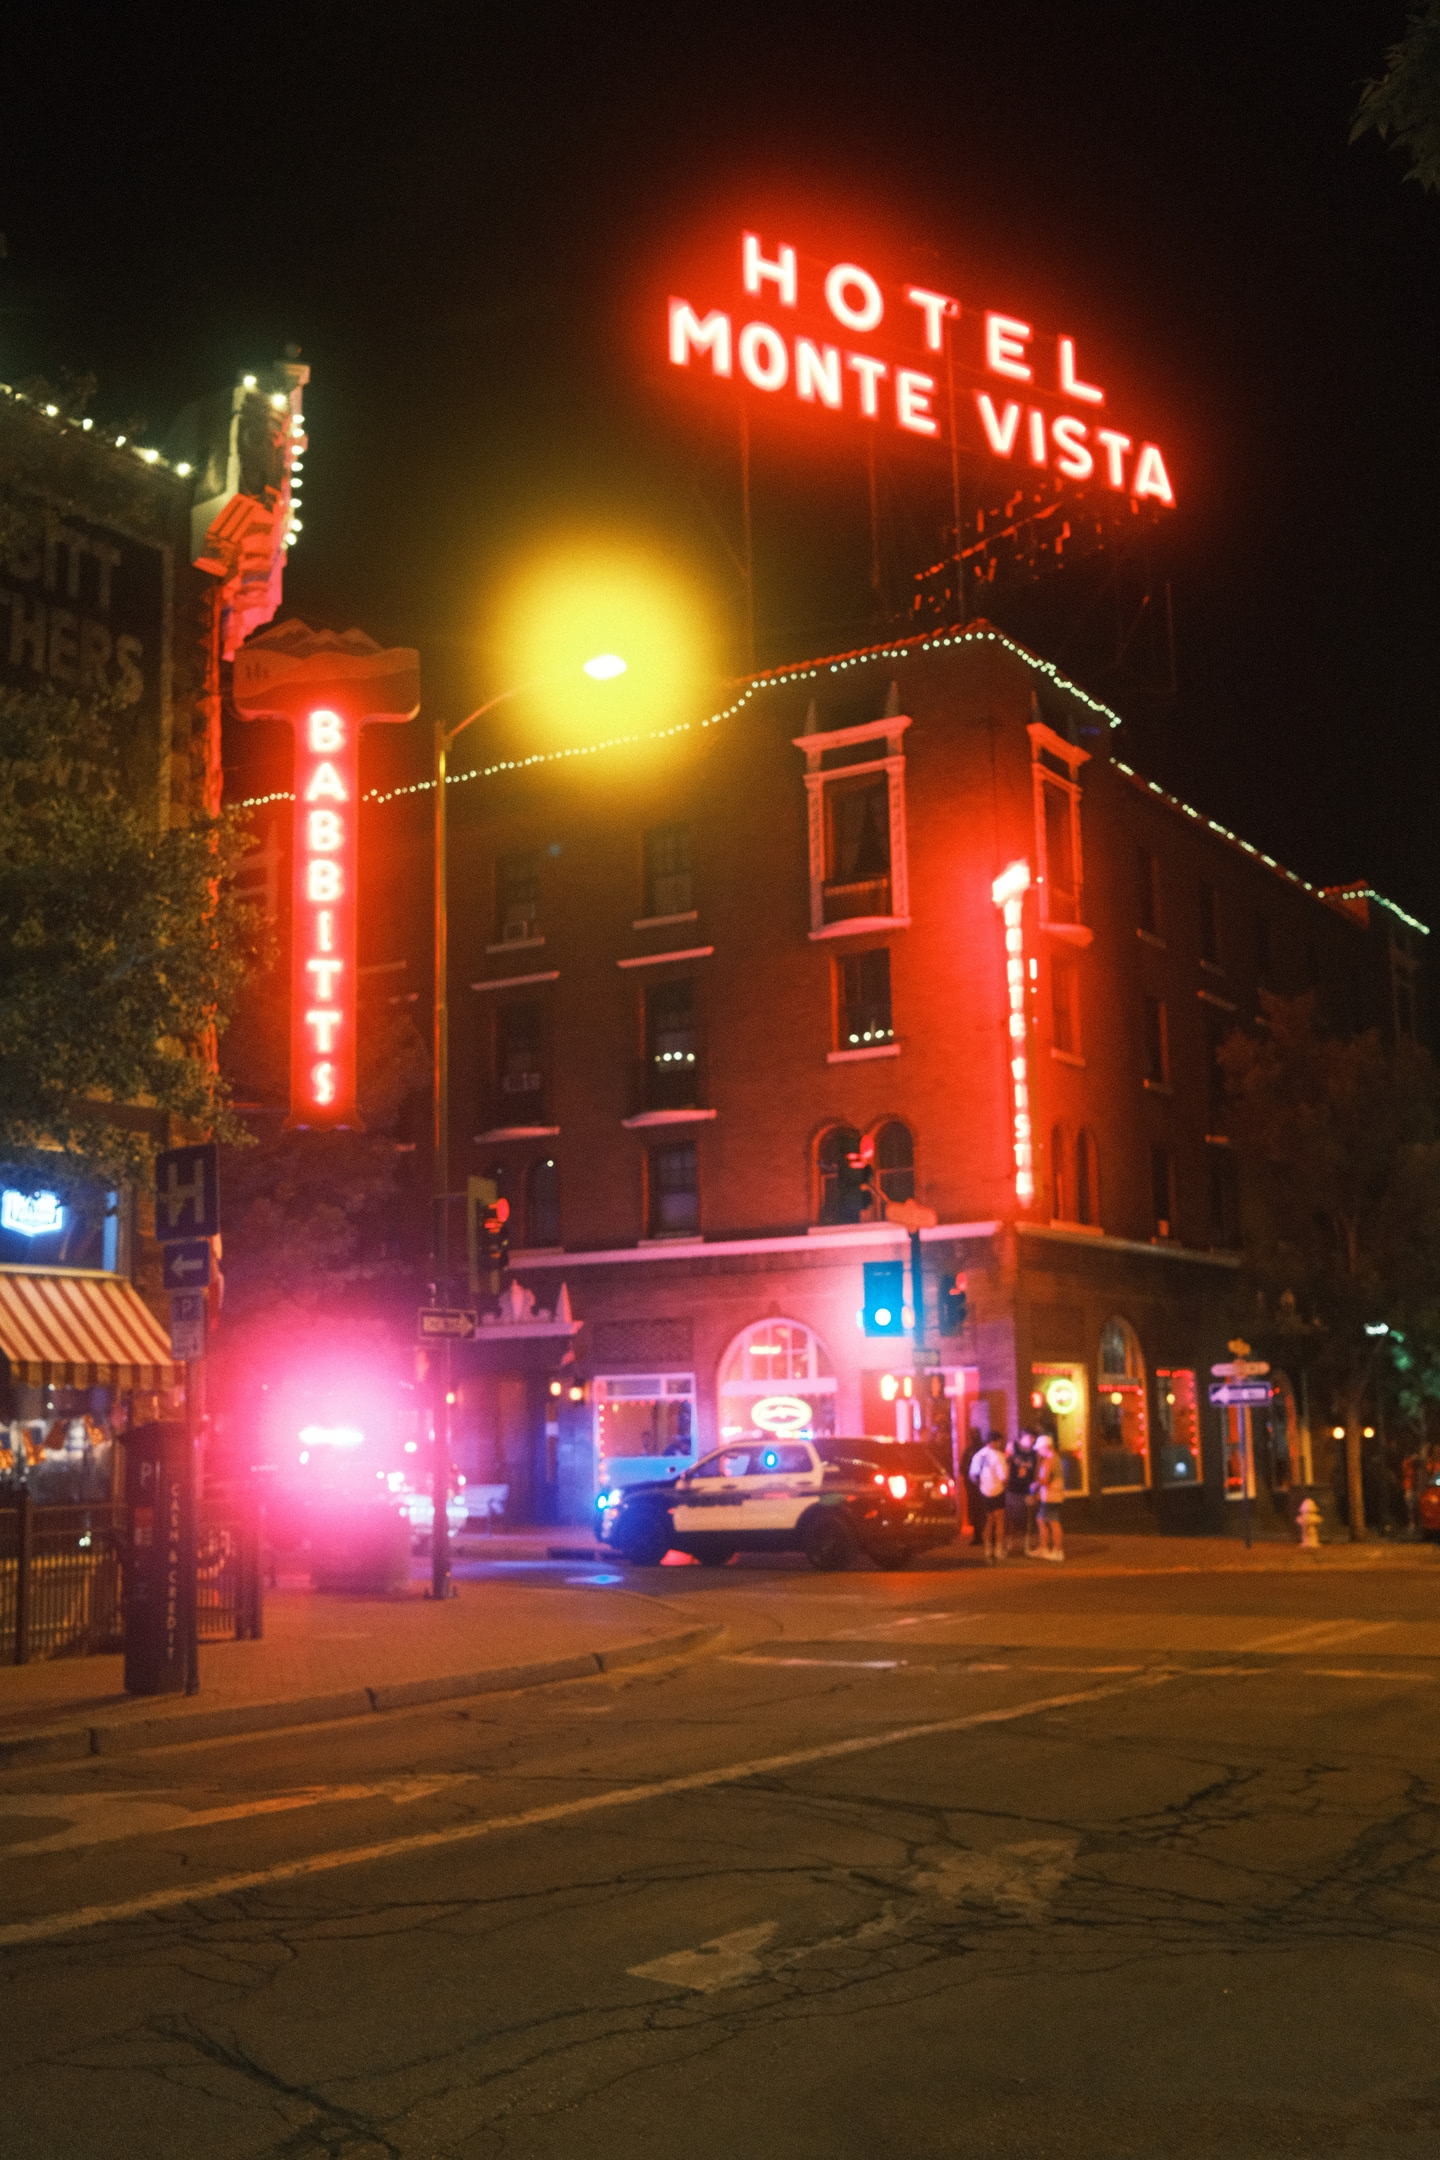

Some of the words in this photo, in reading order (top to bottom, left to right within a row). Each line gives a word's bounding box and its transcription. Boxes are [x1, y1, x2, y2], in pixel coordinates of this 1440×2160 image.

[668, 297, 941, 438] MONTE
[974, 388, 1176, 508] VISTA
[744, 232, 1104, 404] HOTEL
[304, 711, 347, 1105] BABBITTS
